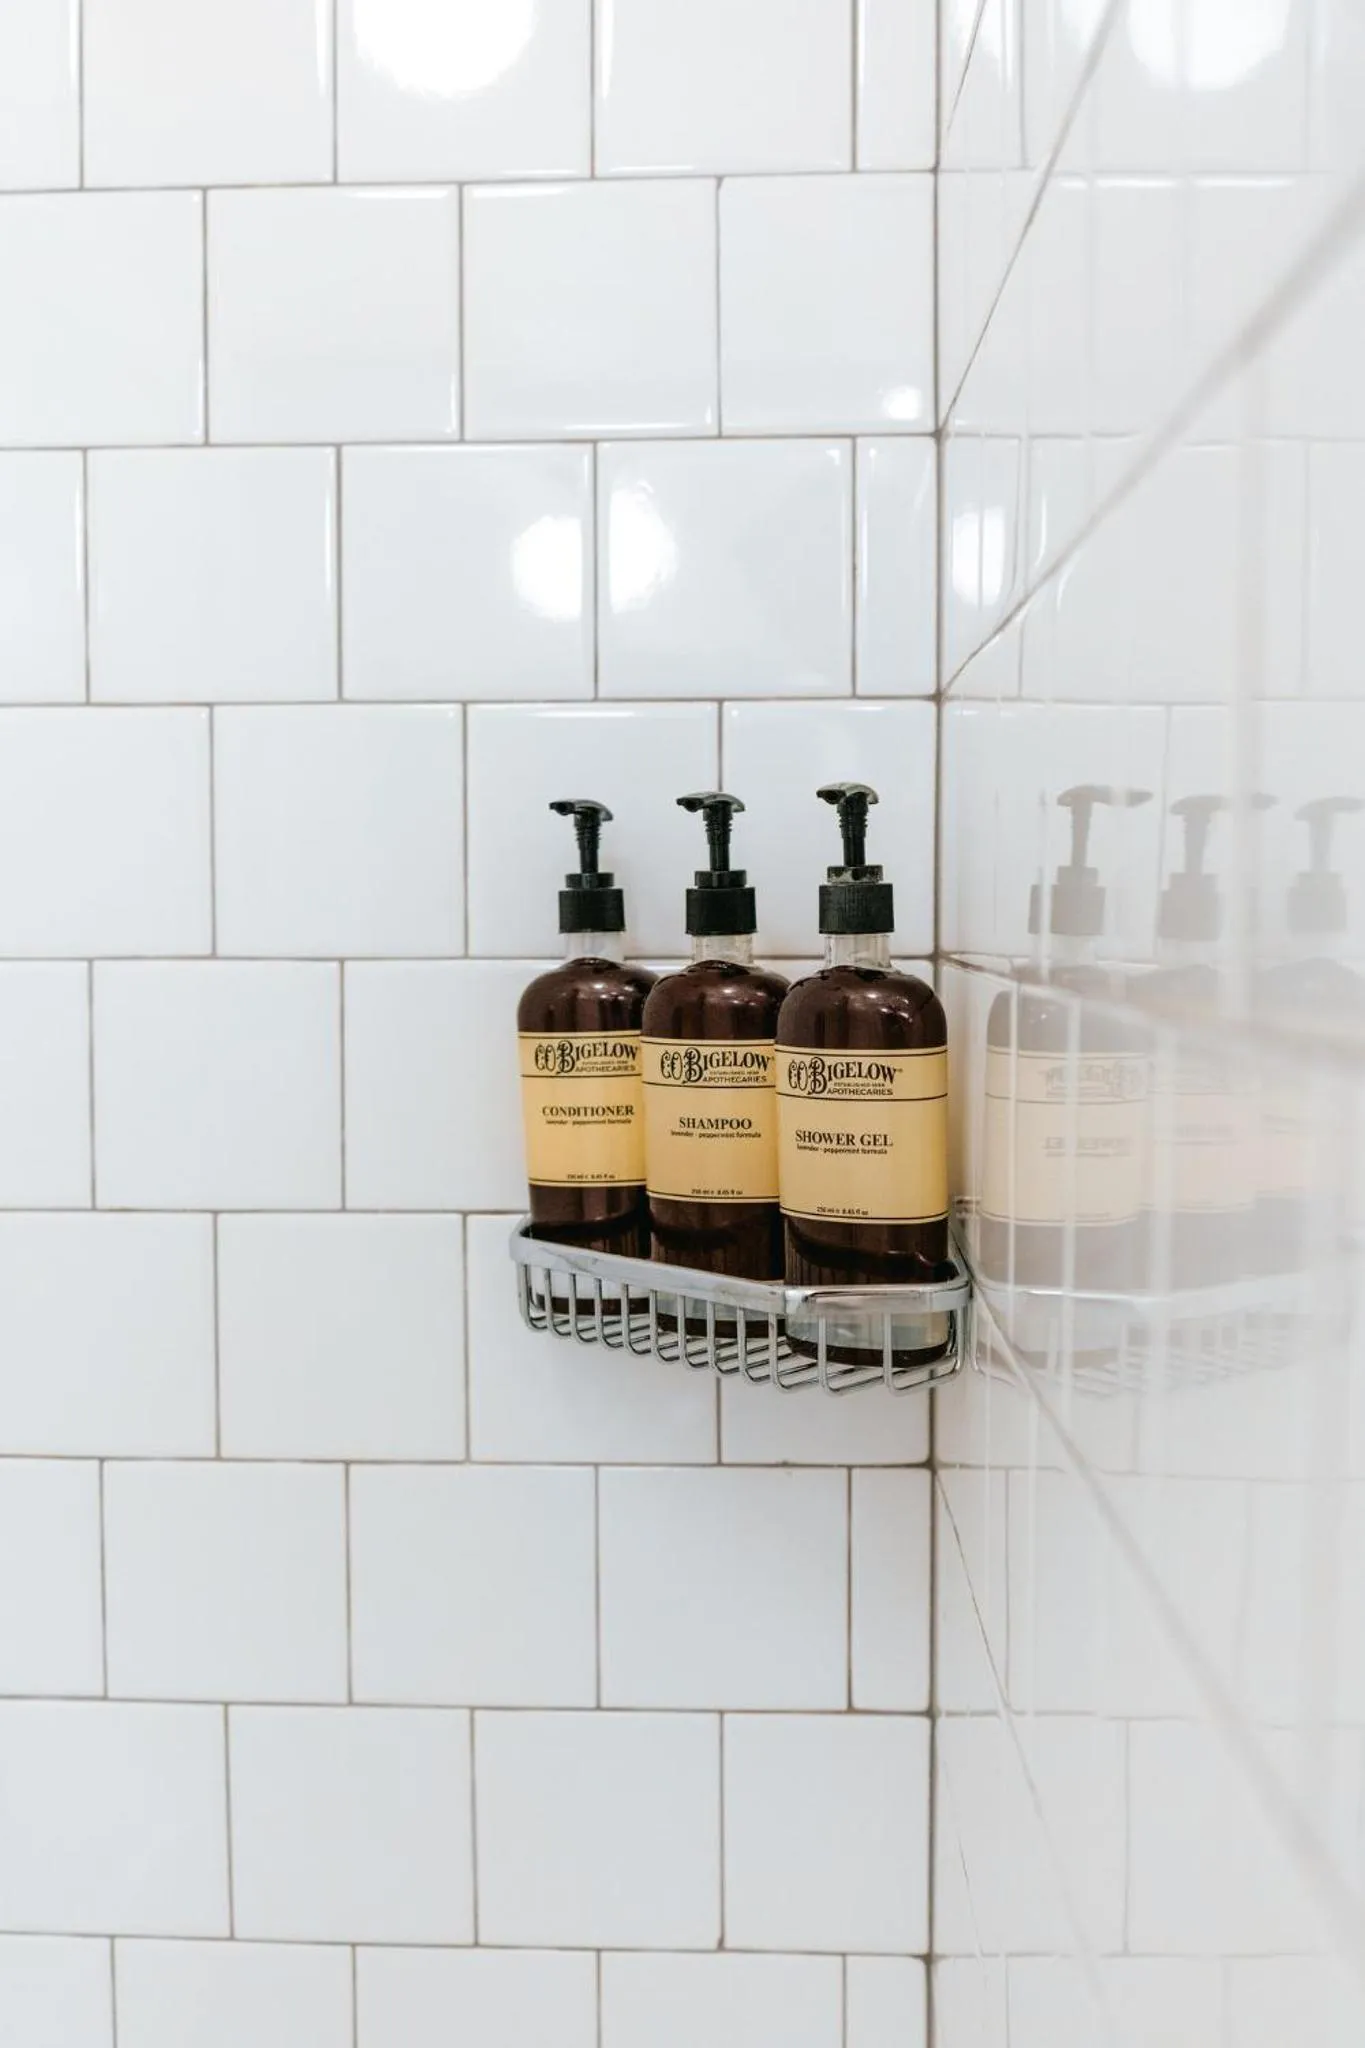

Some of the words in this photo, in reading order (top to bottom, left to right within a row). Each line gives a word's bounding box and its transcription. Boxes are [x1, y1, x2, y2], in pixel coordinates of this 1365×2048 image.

[575, 1065, 636, 1073] APOTHECARIES
[703, 1075, 767, 1084] APOTHECARIES
[827, 1087, 893, 1096] APOTHECARIES
[542, 1105, 634, 1117] CONDITIONER
[679, 1116, 752, 1130] SHAMPOO
[736, 1130, 762, 1138] formula
[795, 1129, 856, 1146] SHOWER
[860, 1134, 894, 1147] GEL
[861, 1147, 888, 1155] formula
